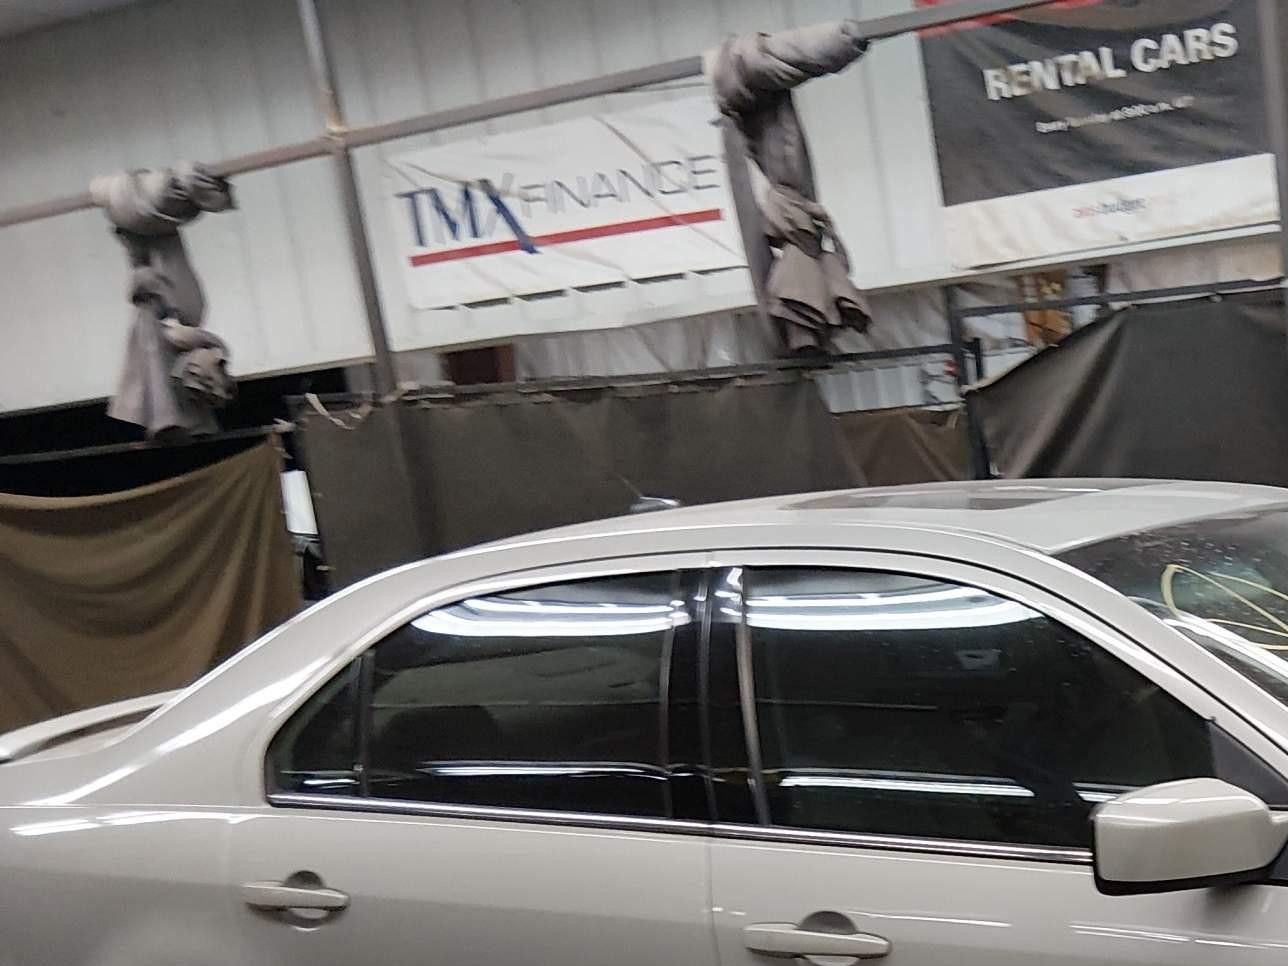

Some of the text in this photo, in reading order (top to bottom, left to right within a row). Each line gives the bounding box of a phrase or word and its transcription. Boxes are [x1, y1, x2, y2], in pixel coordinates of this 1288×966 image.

[982, 22, 1240, 101] RENTAL CARS
[394, 154, 722, 255] TMX FINANCE
